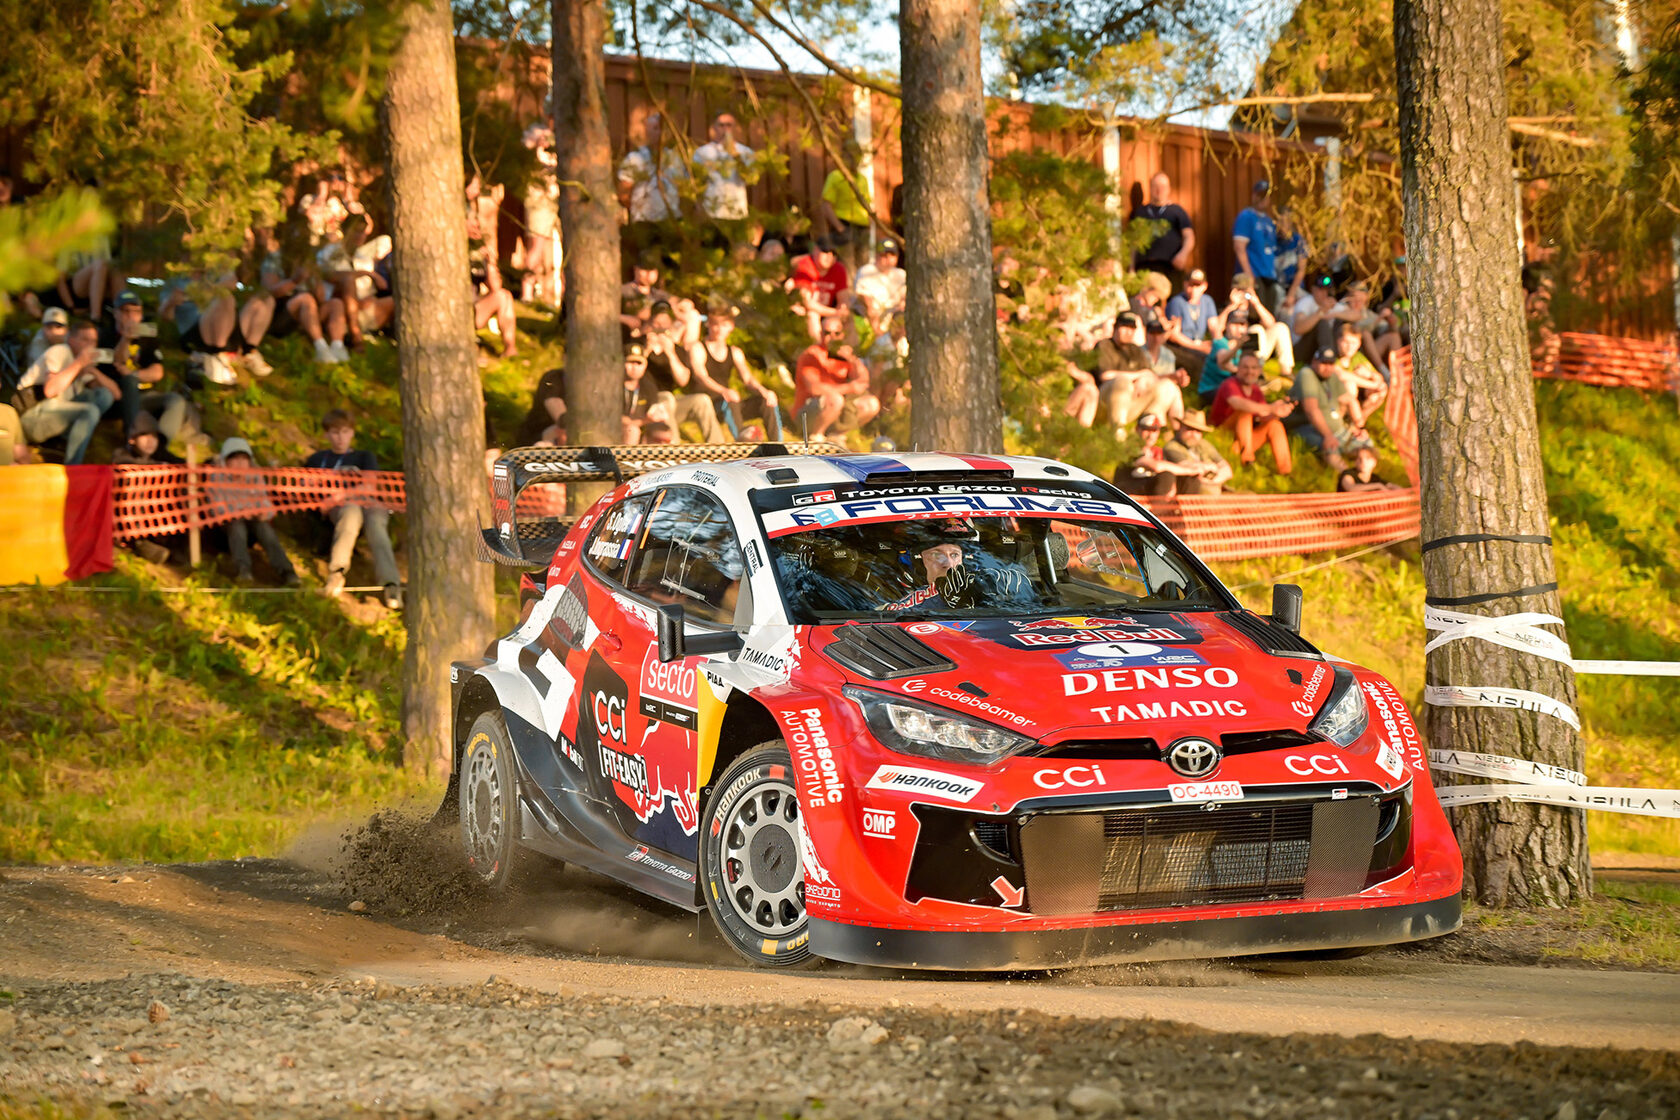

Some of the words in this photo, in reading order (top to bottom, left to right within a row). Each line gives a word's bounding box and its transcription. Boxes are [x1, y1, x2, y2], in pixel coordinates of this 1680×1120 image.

[524, 462, 598, 473] GIVE
[691, 470, 719, 487] PROTERIAL
[842, 486, 932, 499] TOYOTA
[938, 484, 1017, 496] GAZOO
[1021, 485, 1092, 502] Racing
[841, 496, 1118, 519] FORUM8
[745, 541, 762, 573] CENTRAL
[1010, 630, 1100, 646] Red
[1098, 628, 1187, 642] Bull
[743, 648, 785, 671] TAMADIC
[1108, 645, 1129, 654] 1
[647, 659, 695, 698] secto
[707, 671, 726, 688] PIAA
[1063, 667, 1240, 697] DENSO
[930, 685, 1035, 728] codebeamer
[1090, 700, 1248, 723] TAMADIC
[1374, 680, 1425, 771] AUTOMOTIVE
[778, 710, 825, 809] AUTOMOTIVE
[798, 707, 844, 804] Panasonic
[1172, 783, 1242, 800] OC-4490
[863, 813, 896, 834] OMP
